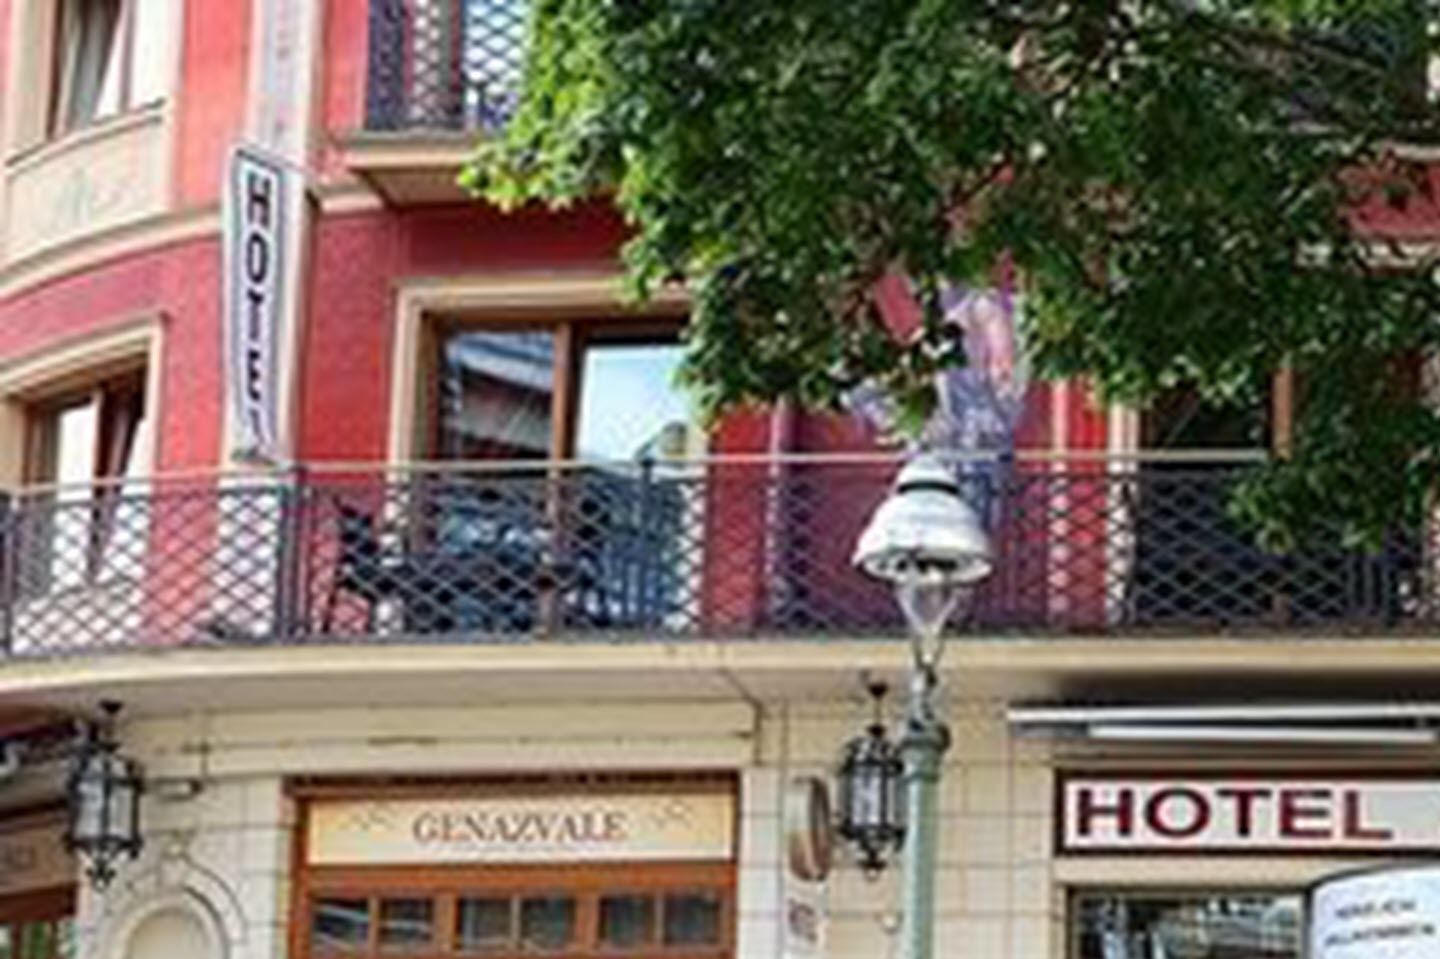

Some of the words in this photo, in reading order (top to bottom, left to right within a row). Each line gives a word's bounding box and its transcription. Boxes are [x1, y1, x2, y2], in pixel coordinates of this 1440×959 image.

[245, 166, 273, 444] HOTEL
[411, 811, 628, 844] GENAZVALE
[1075, 787, 1392, 839] HOTEL
